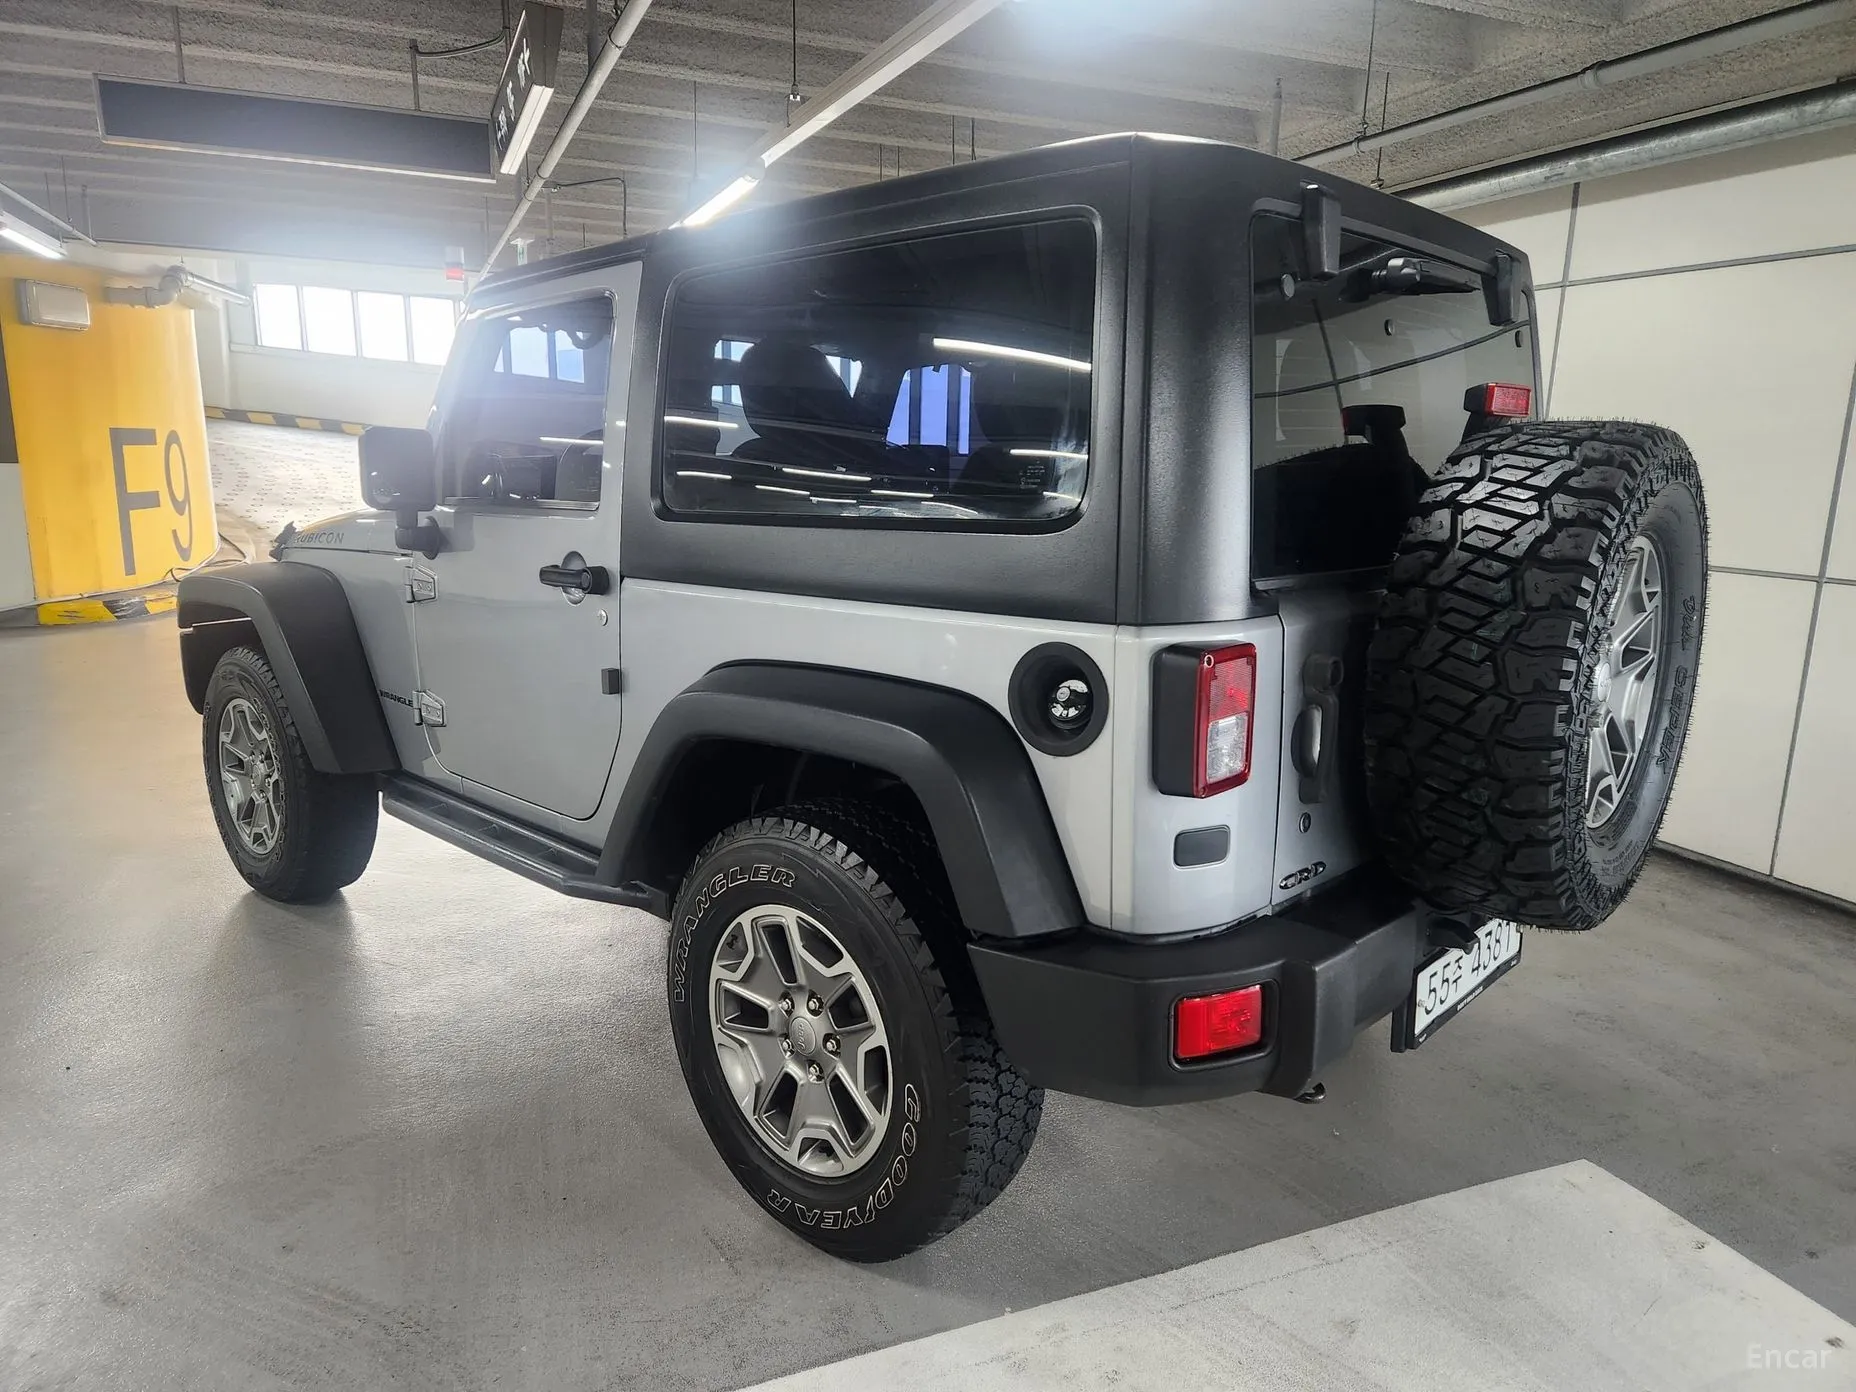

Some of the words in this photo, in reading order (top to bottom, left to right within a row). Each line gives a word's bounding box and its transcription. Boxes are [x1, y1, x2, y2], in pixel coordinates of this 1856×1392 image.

[109, 427, 193, 576] F9
[379, 689, 414, 708] WRANGLE
[674, 864, 796, 1003] WRANGLER
[1424, 955, 1463, 1015] 55주
[767, 1083, 921, 1230] GOODYEAR
